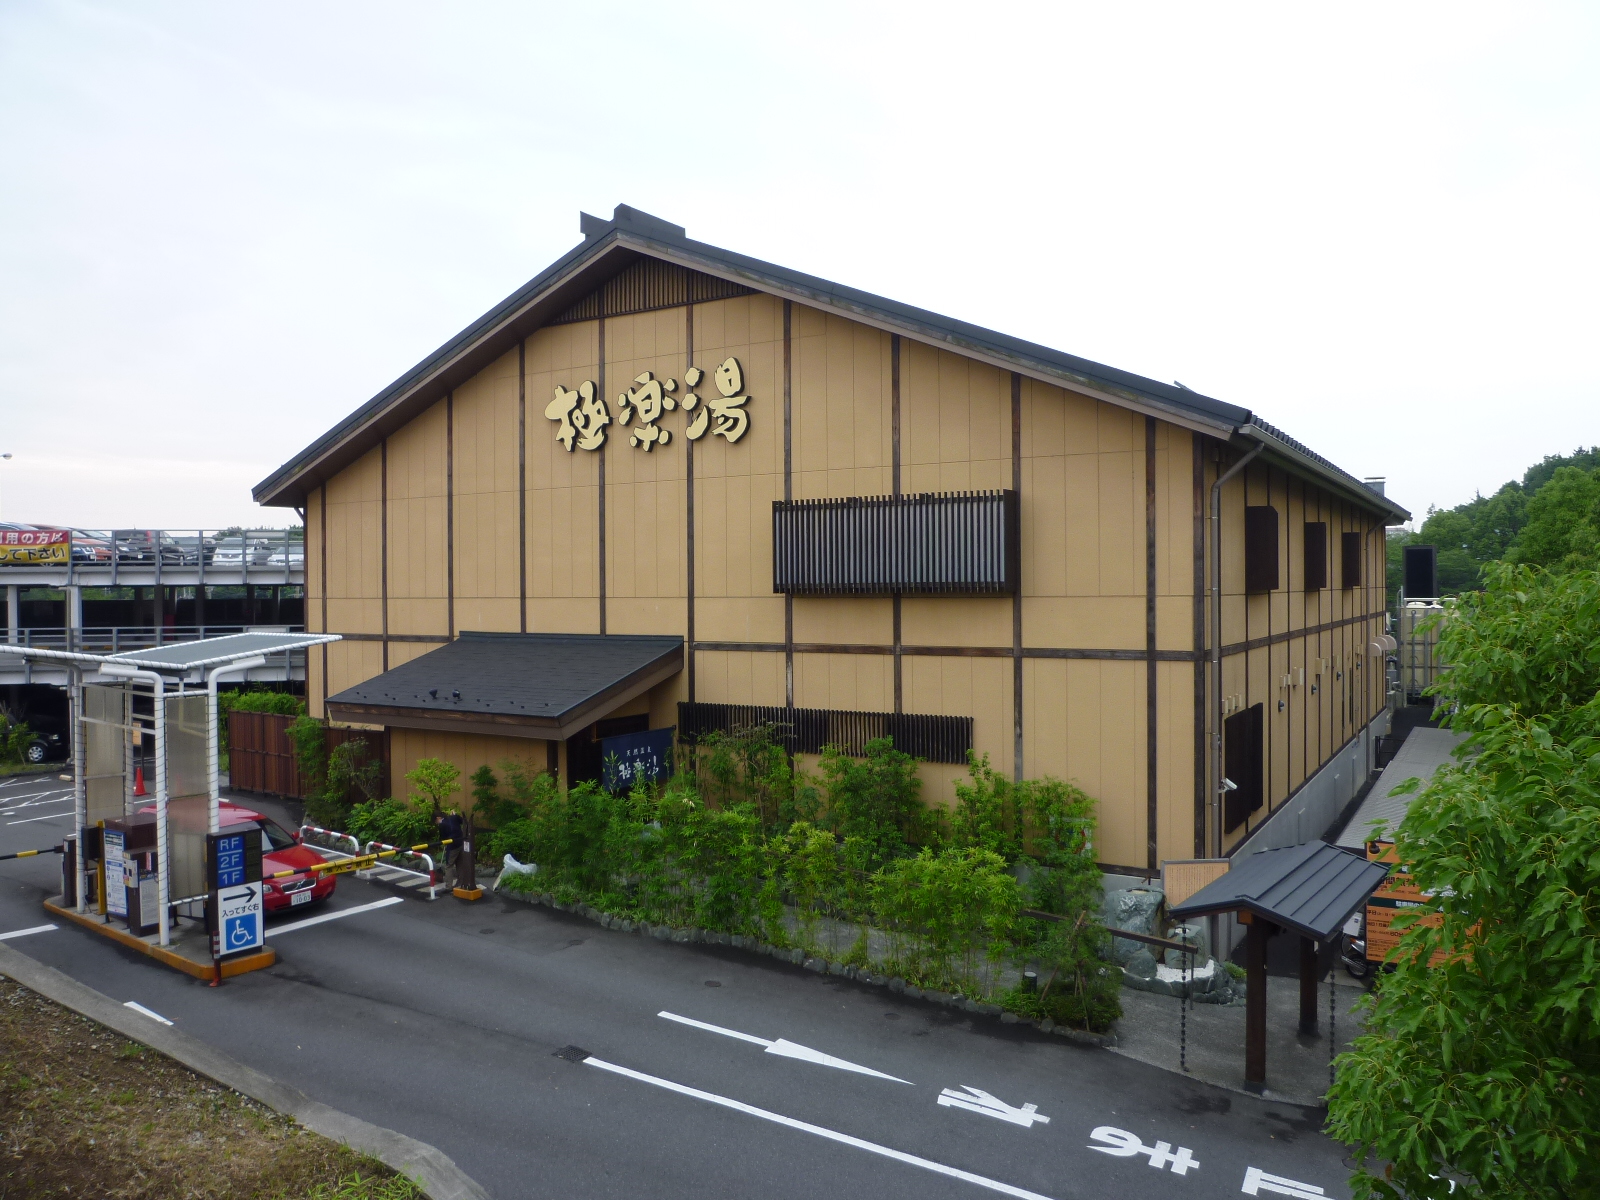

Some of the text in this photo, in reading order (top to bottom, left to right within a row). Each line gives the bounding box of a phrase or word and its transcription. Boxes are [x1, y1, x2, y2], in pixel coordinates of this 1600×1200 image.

[544, 356, 752, 453] 極楽湯
[220, 837, 240, 851] RF
[220, 854, 240, 868] 2F
[222, 871, 240, 885] 1F
[221, 903, 260, 918] 入ってすぐ右
